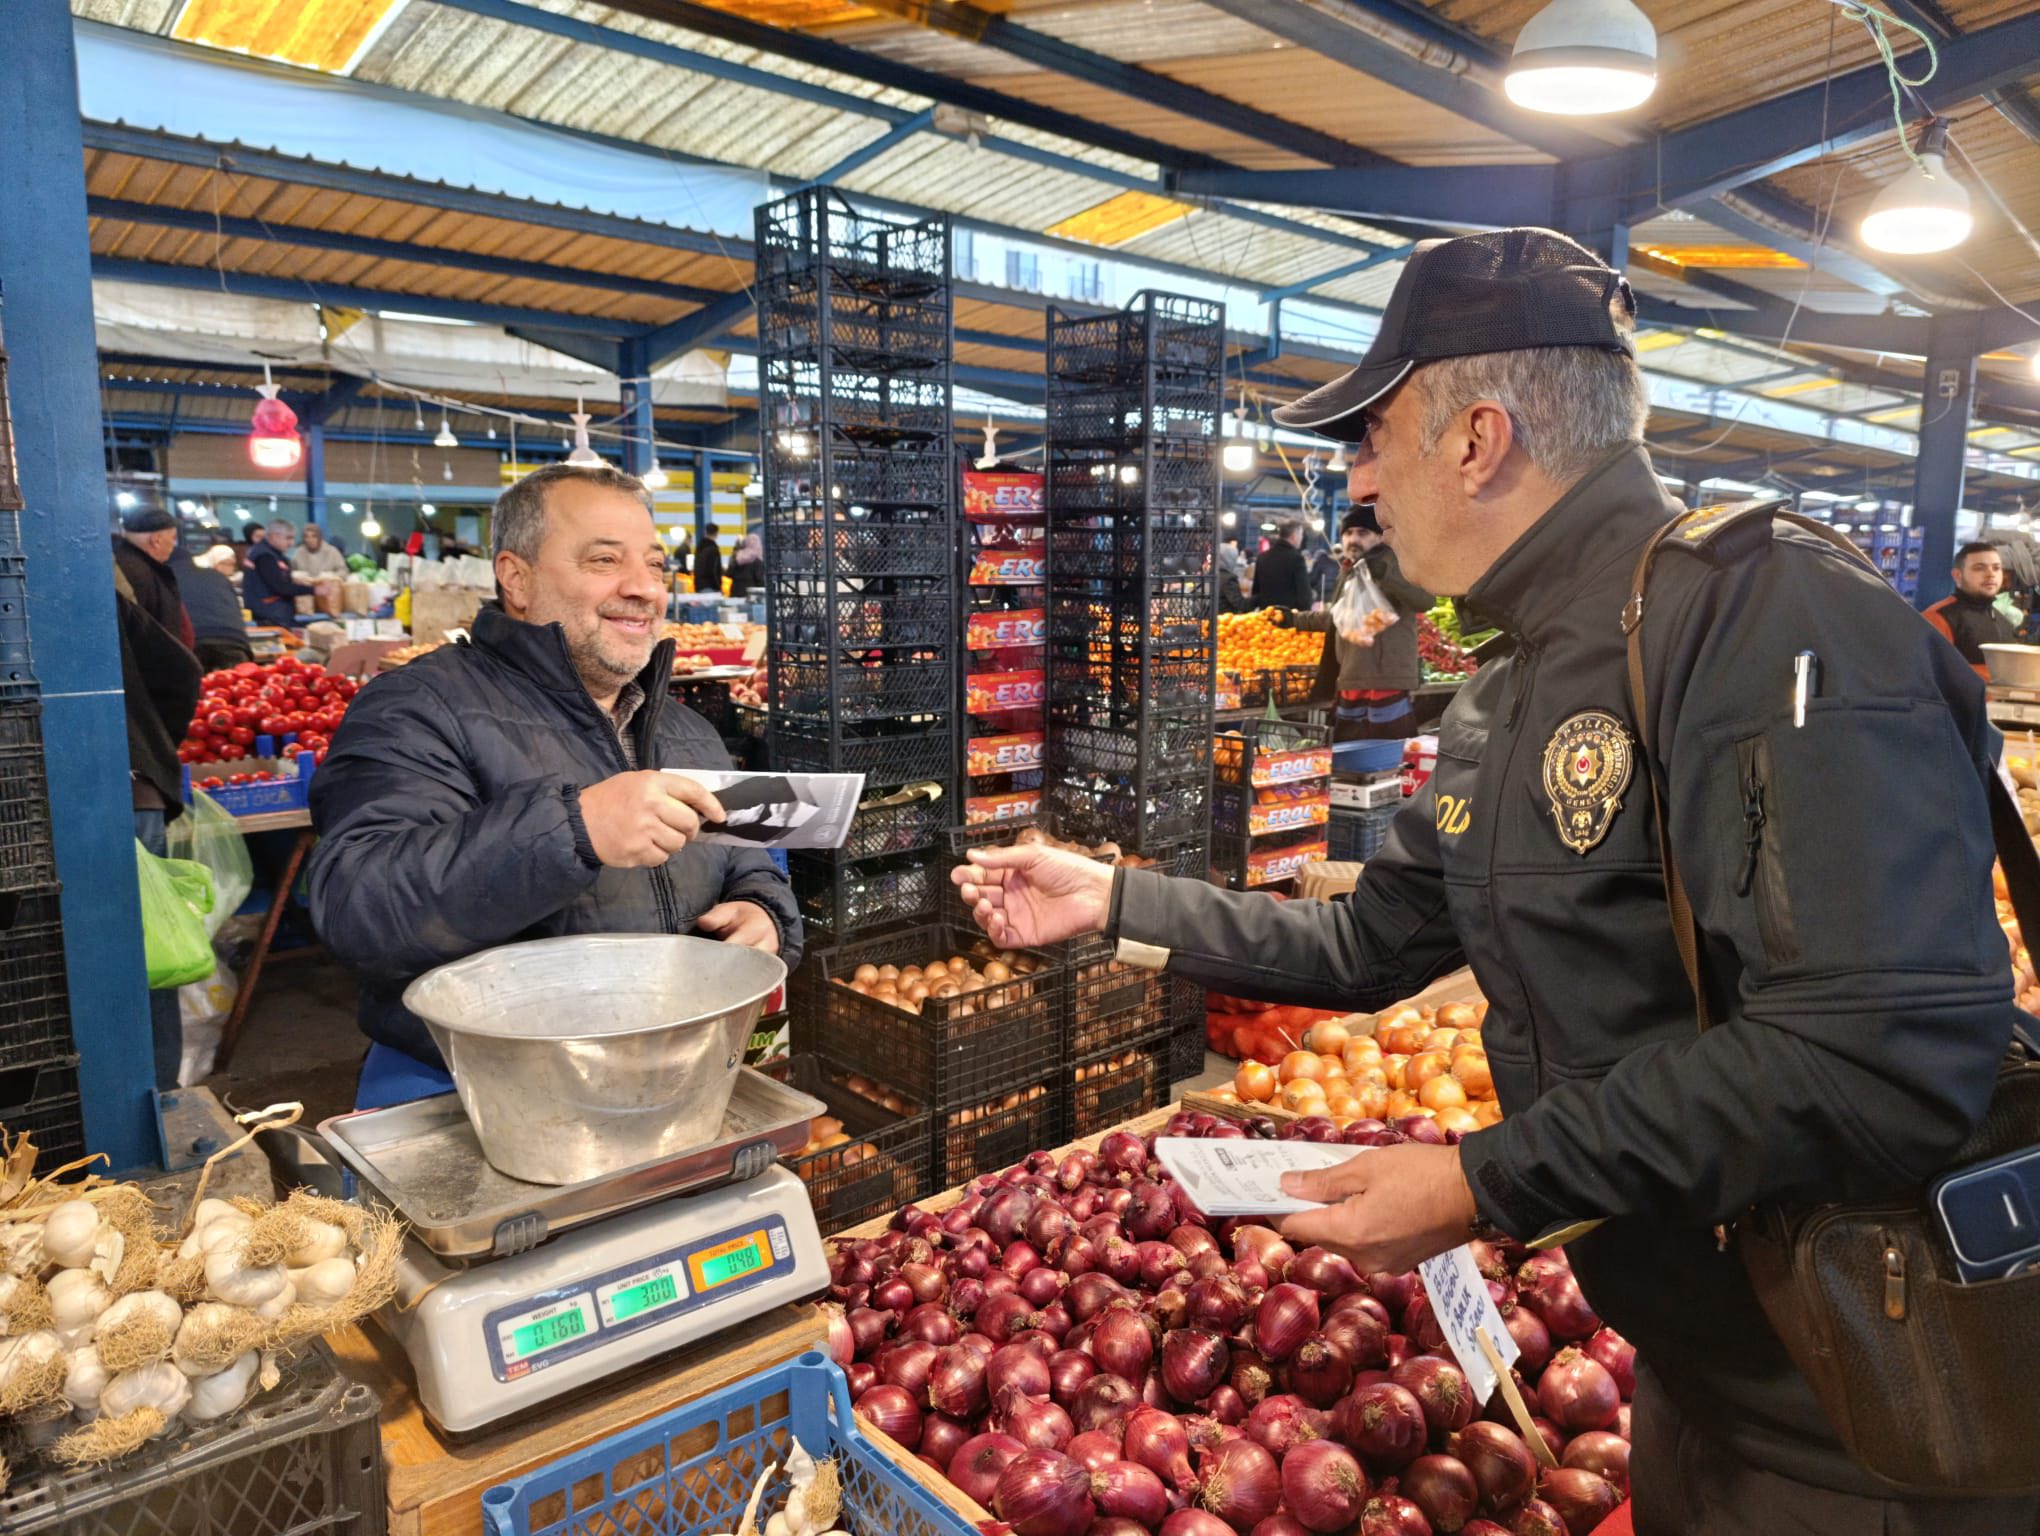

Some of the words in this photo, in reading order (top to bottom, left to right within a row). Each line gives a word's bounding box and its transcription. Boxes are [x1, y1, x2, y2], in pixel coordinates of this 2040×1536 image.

[1269, 757, 1314, 778] EROL
[1266, 804, 1312, 825] EROL
[632, 1273, 650, 1284] PRICE
[531, 1307, 557, 1321] WEIGHT
[533, 1311, 581, 1347] 0.160
[507, 1361, 529, 1375] TEM
[531, 1359, 550, 1372] EVG
